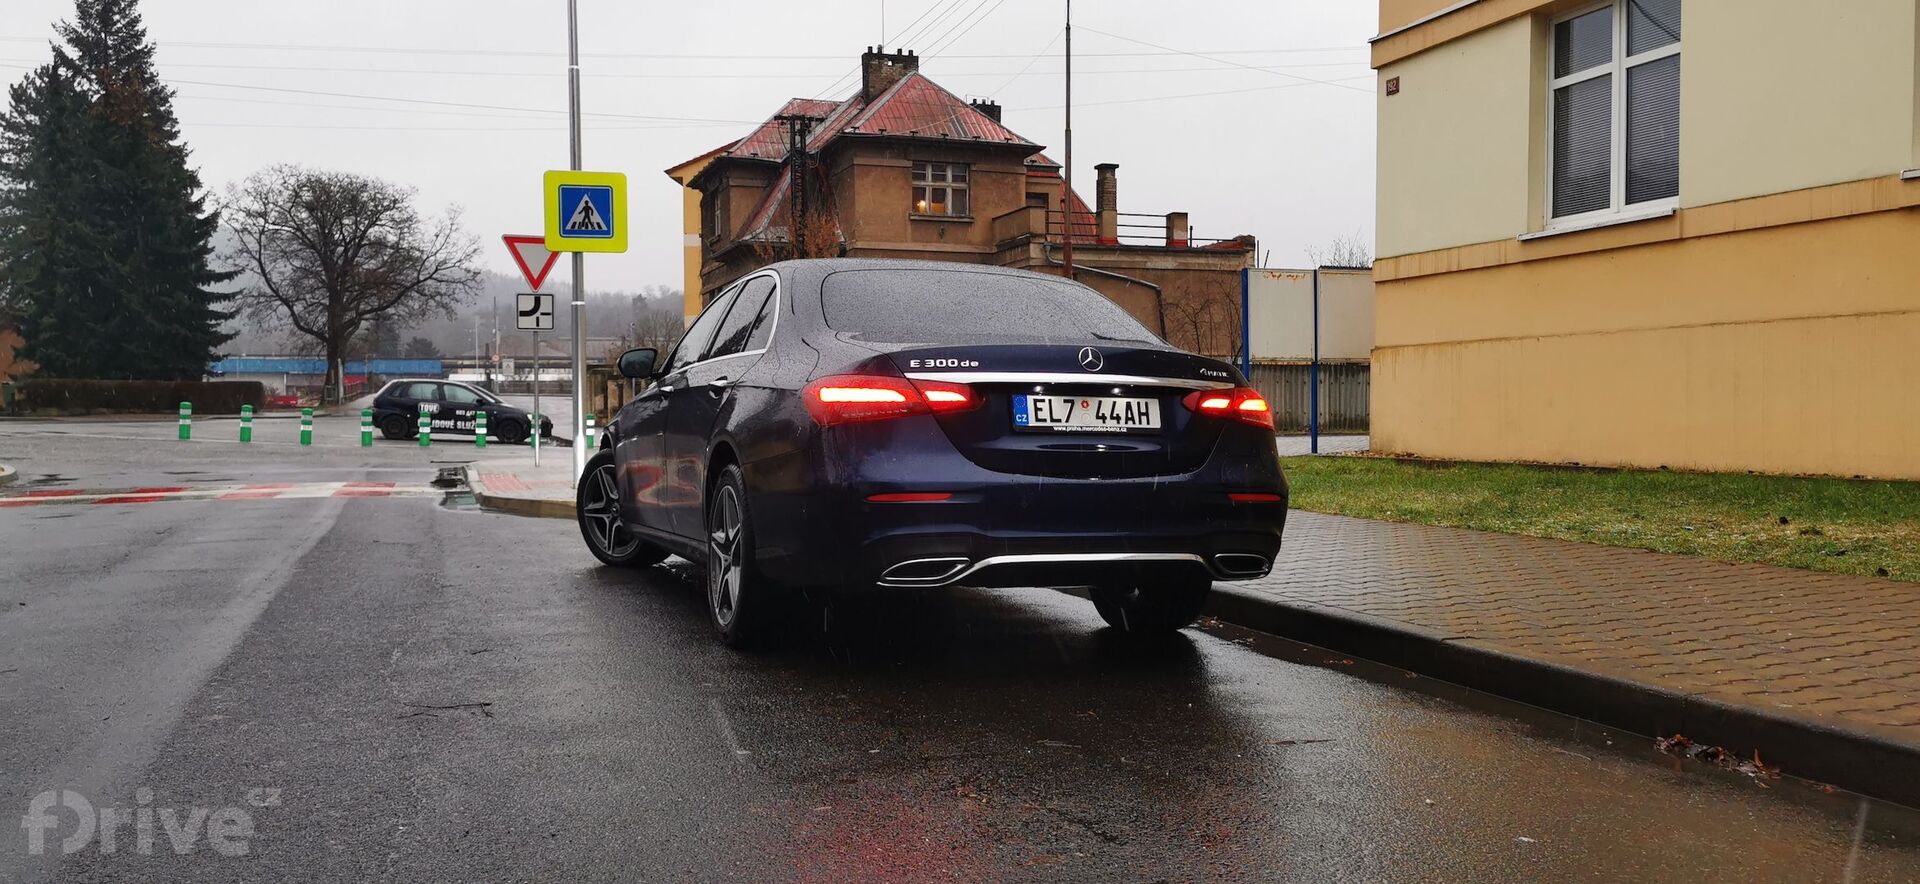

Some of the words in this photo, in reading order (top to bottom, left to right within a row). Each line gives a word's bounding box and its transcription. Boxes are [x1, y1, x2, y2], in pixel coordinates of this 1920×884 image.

[910, 359, 920, 367] E
[924, 359, 958, 367] 300
[960, 359, 979, 367] de
[1032, 398, 1075, 423] EL7
[1095, 400, 1150, 425] 44AH
[1016, 414, 1027, 422] CZ
